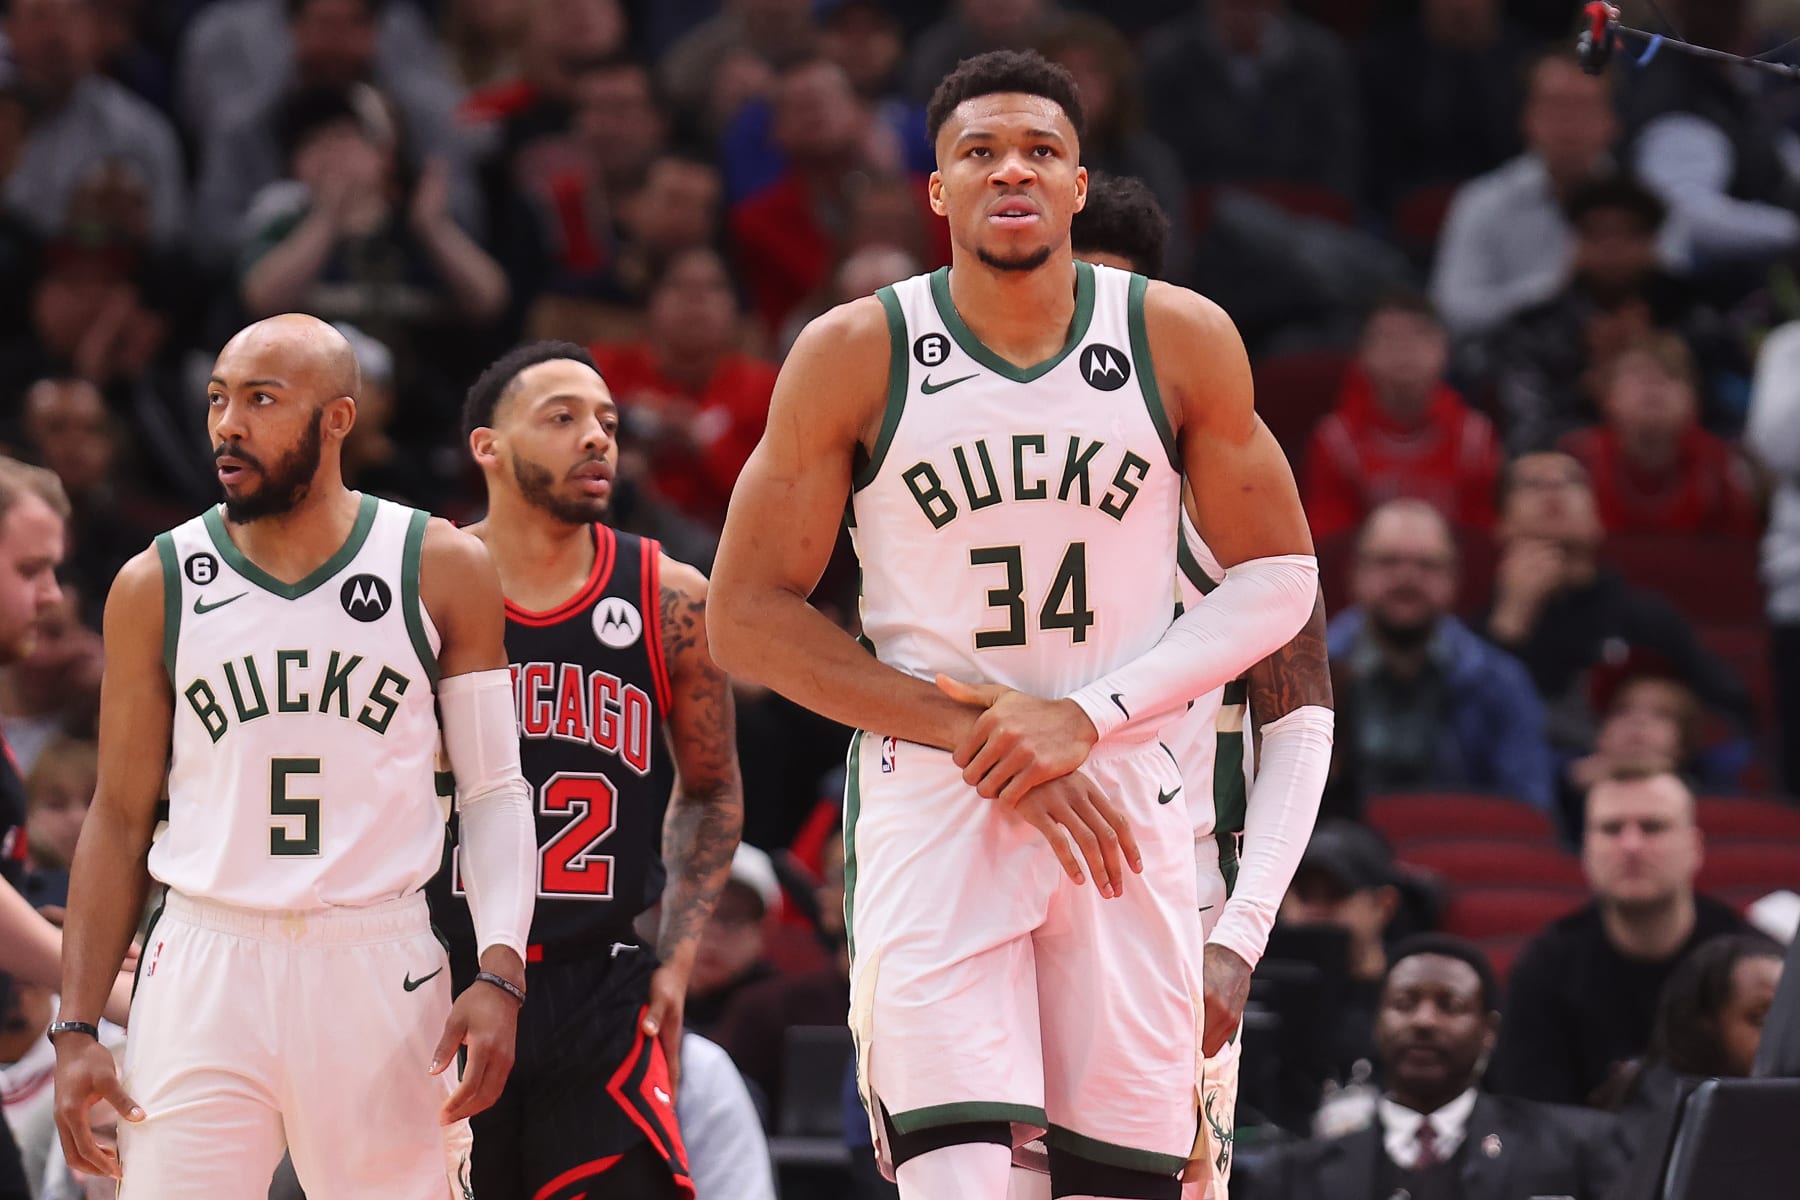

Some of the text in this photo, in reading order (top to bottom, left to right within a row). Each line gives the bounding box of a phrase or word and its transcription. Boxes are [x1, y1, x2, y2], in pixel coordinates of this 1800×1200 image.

[922, 337, 942, 363] 6
[900, 433, 1152, 531] BUCKS
[192, 556, 211, 583] 6
[969, 540, 1095, 649] 34
[183, 649, 411, 745] BUCKS
[268, 756, 323, 858] 5
